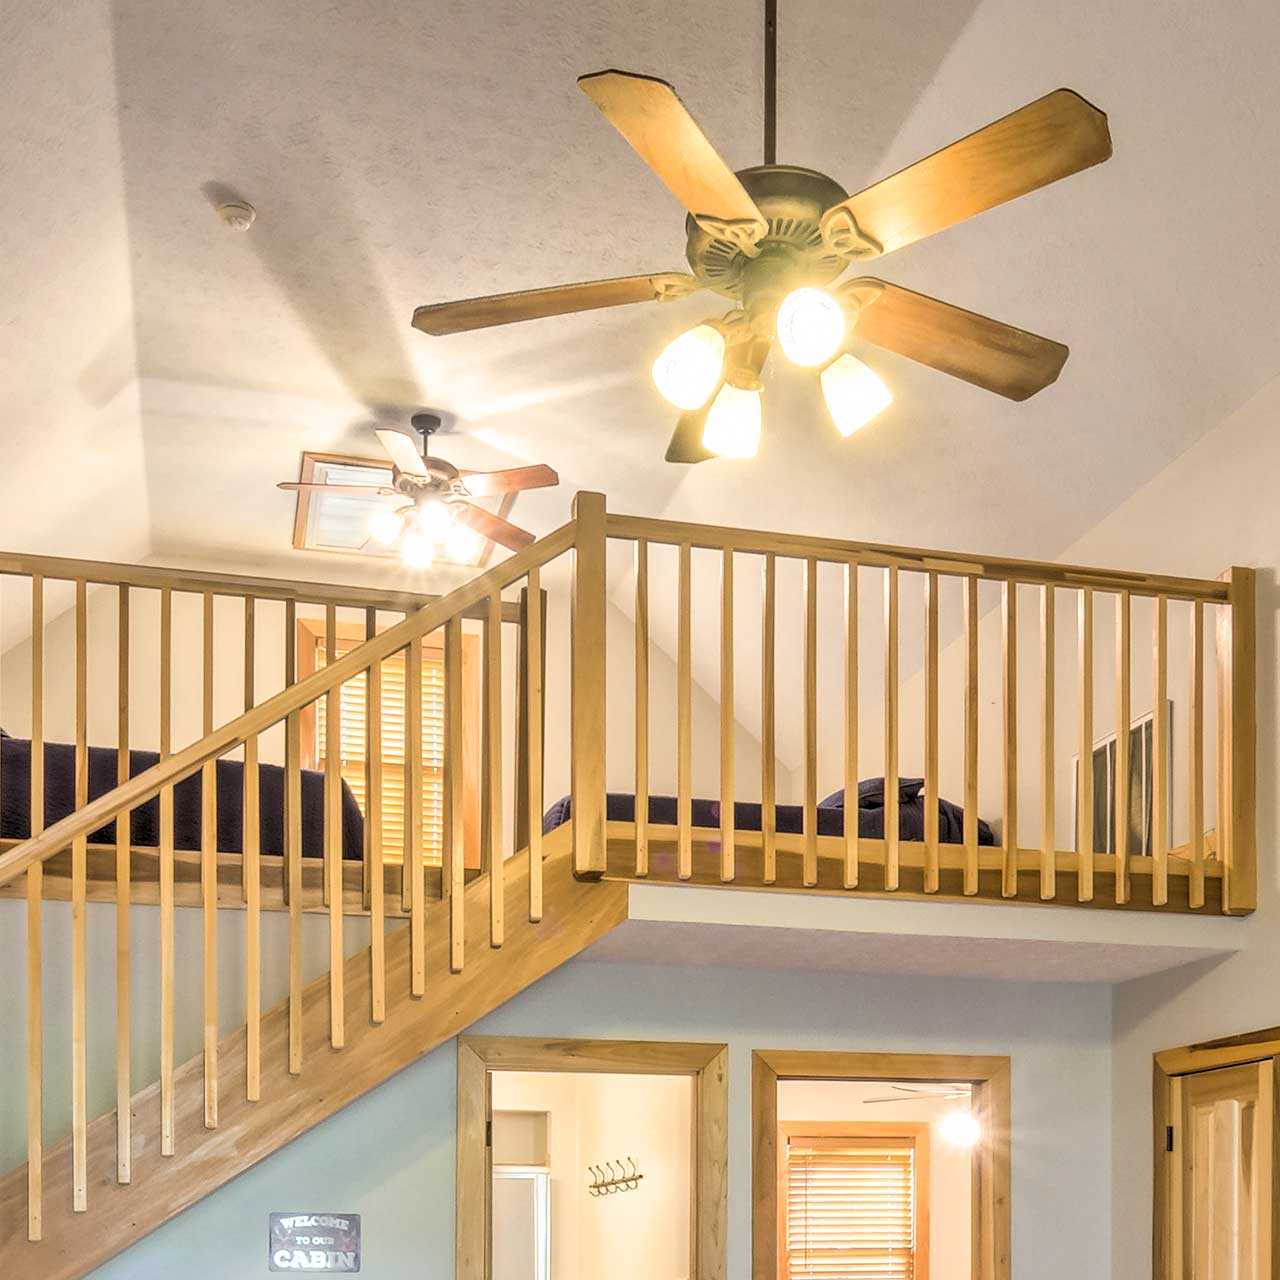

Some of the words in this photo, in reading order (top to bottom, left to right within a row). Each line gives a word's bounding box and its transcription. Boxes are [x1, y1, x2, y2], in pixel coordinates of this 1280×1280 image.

[280, 1216, 349, 1232] WELCOME
[296, 1236, 310, 1245] TO
[312, 1236, 334, 1245] OUR
[274, 1250, 355, 1268] CABIN
